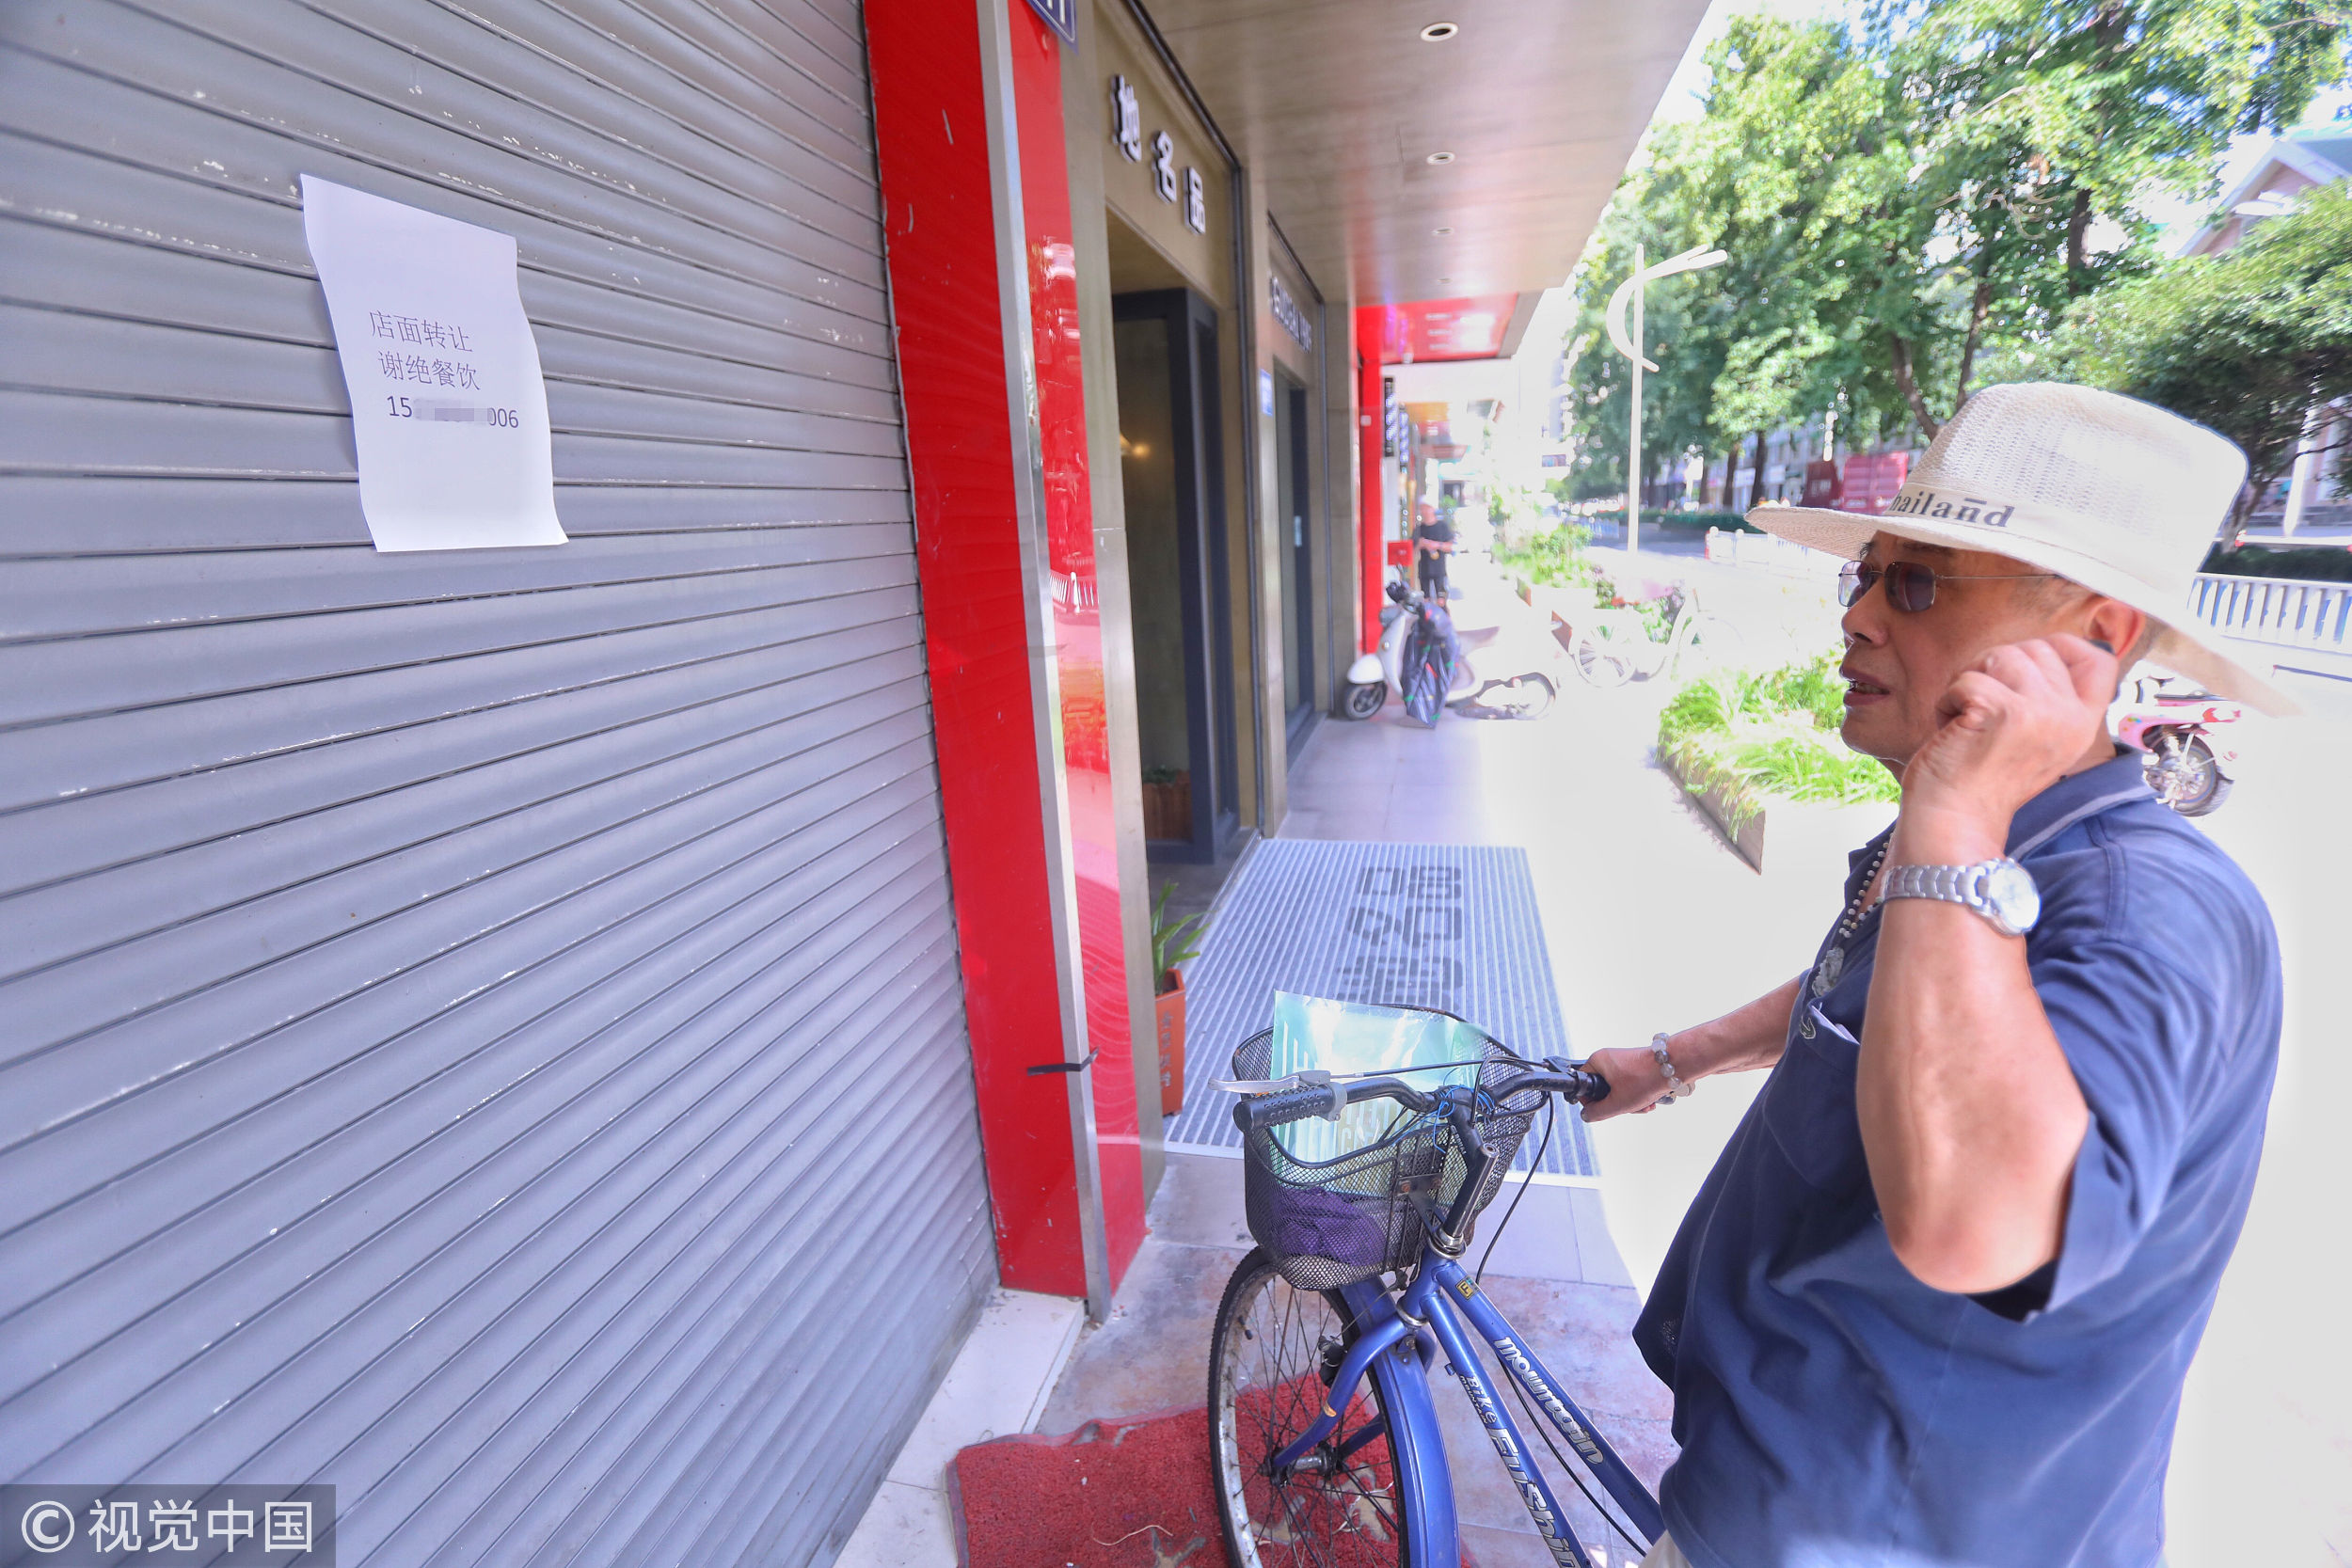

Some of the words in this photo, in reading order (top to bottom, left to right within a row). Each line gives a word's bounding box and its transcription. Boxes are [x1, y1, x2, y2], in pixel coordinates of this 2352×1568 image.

[370, 310, 473, 352] 店面转让
[378, 351, 481, 390] 谢绝餐饮
